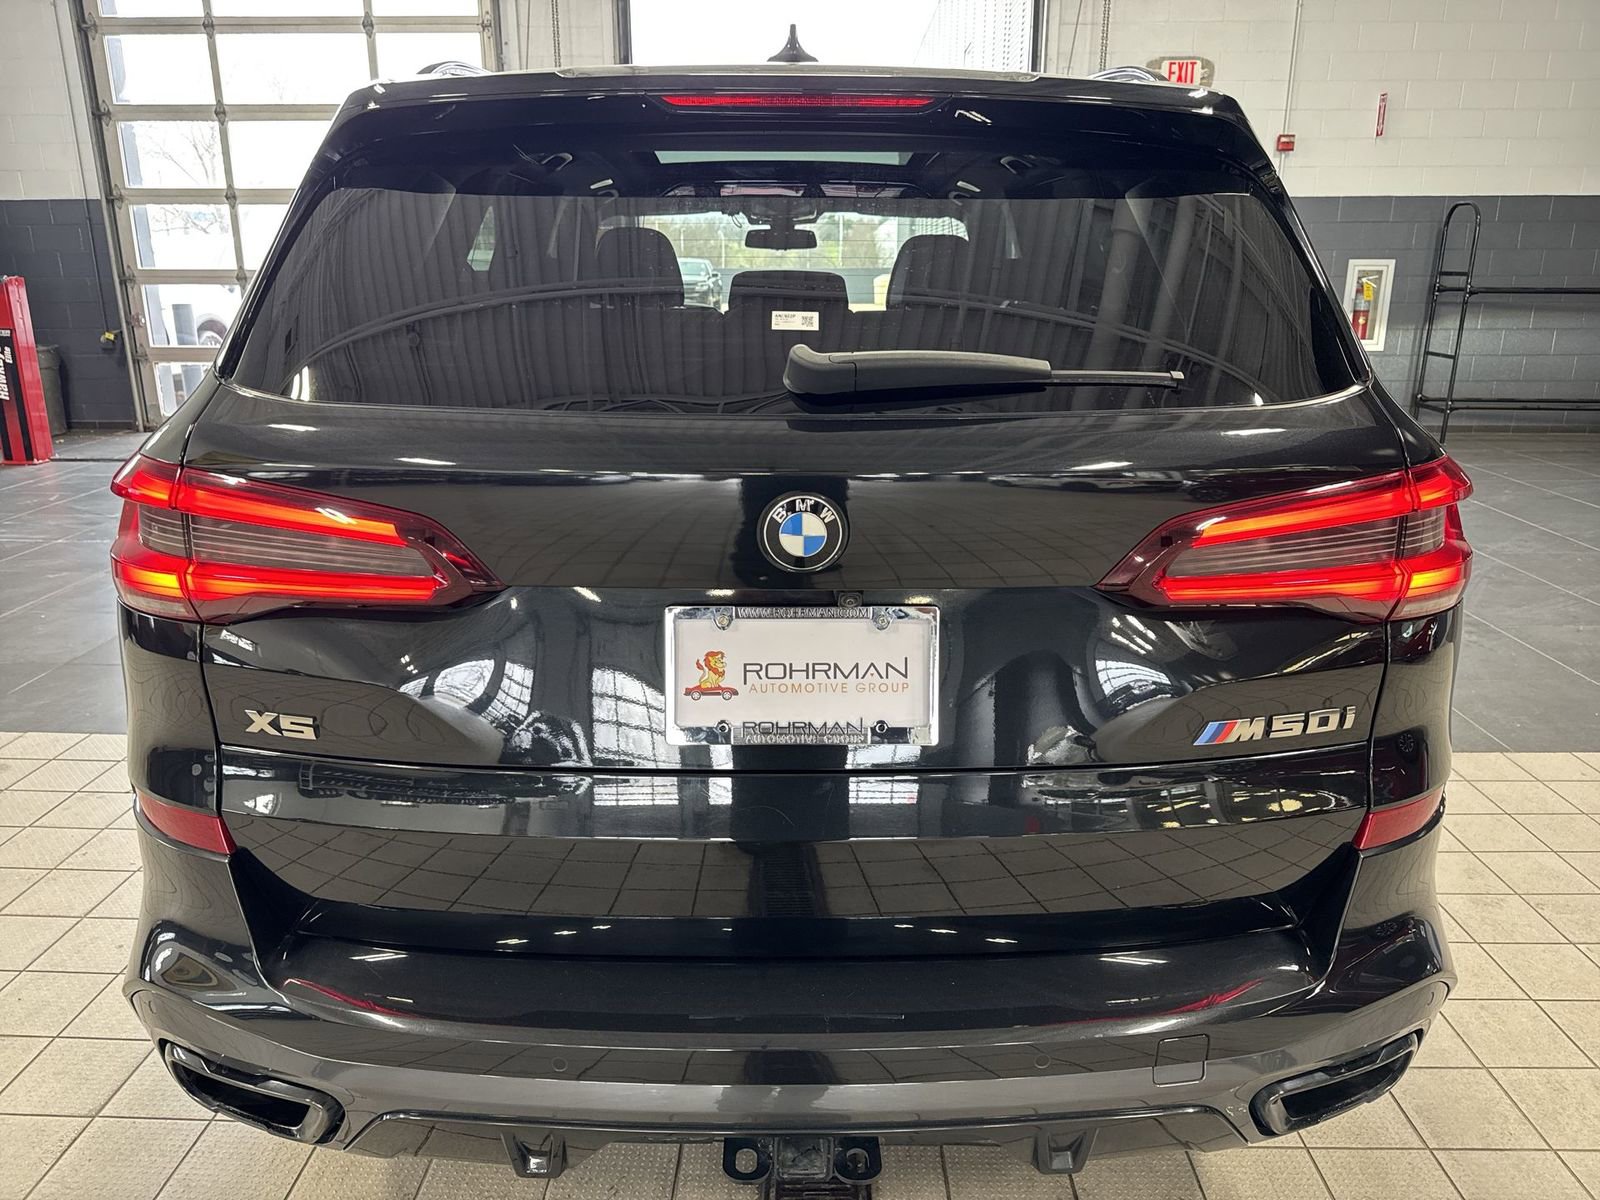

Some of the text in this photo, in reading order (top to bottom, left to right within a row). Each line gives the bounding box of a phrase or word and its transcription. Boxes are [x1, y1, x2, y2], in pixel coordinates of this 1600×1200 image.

[1168, 61, 1197, 84] EXIT
[772, 499, 835, 523] BMW
[743, 657, 908, 685] ROHRMAN
[750, 682, 909, 694] AUTOMOTIVE GROUP
[244, 709, 317, 740] X5
[742, 717, 863, 738] ROHRMAN
[1216, 706, 1357, 745] M50i
